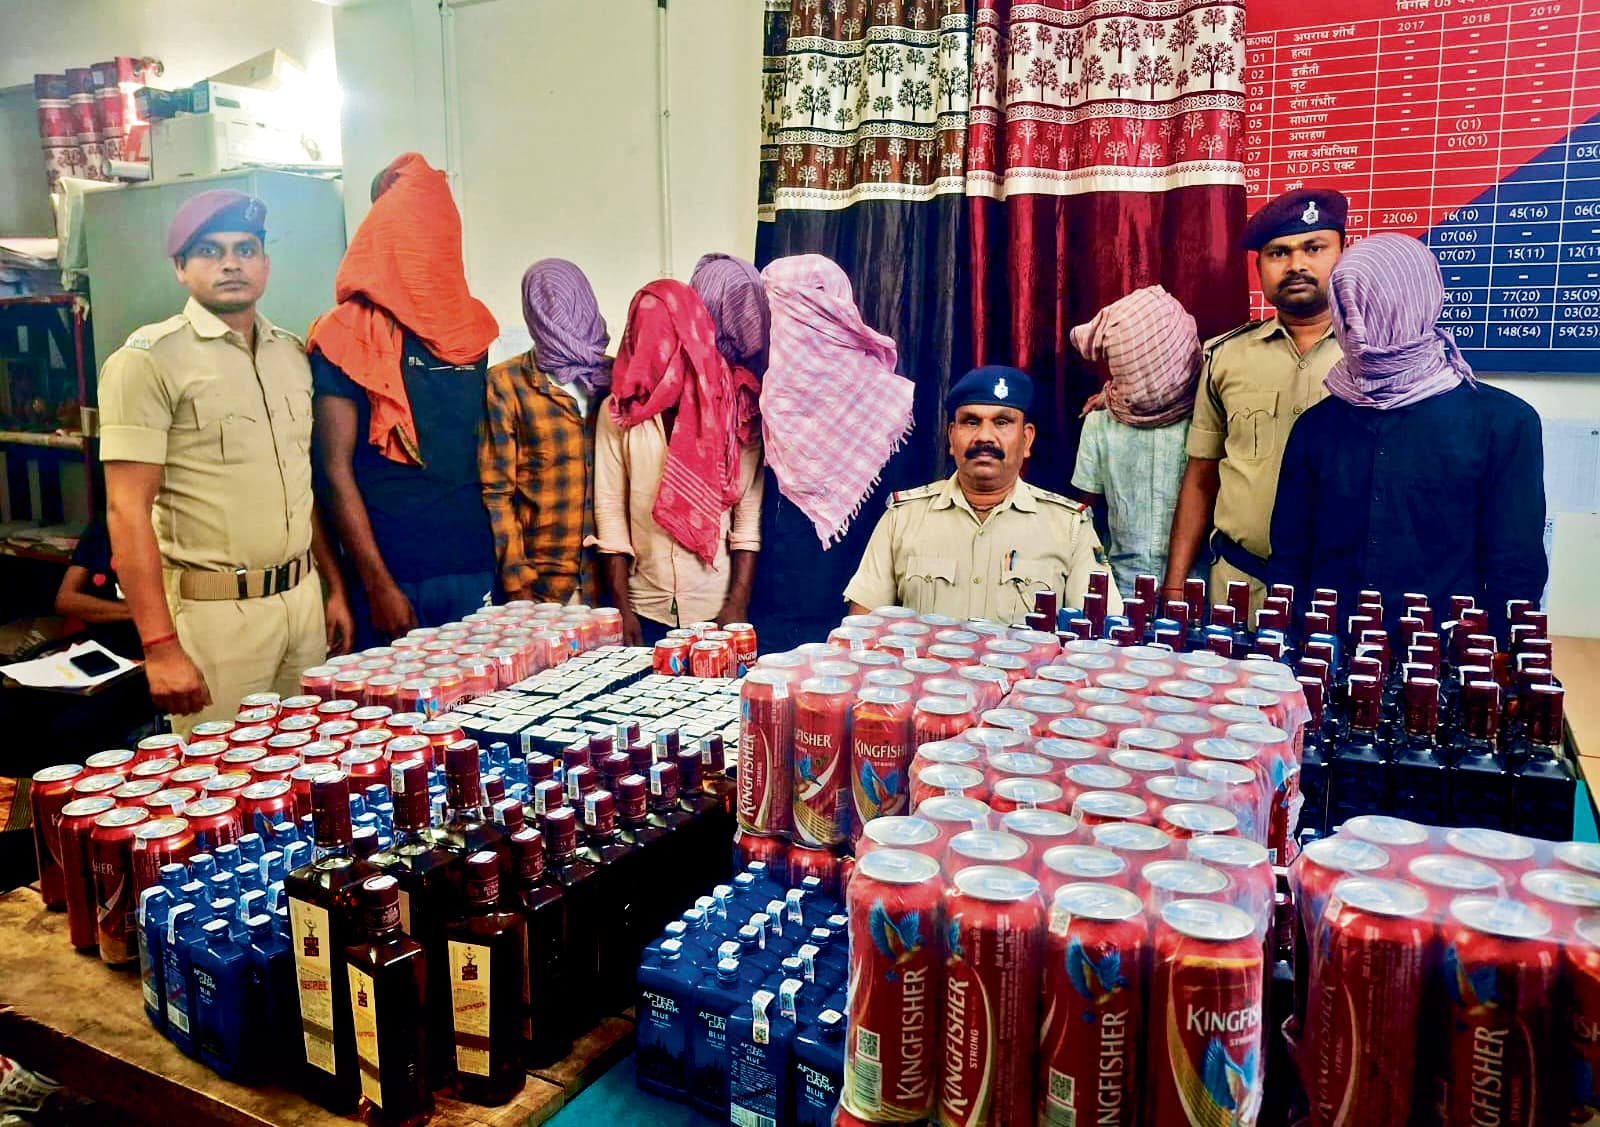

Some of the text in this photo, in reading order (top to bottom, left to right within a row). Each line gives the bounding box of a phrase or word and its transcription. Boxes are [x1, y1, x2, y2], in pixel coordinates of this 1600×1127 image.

[1397, 20, 1424, 31] 2017
[1462, 13, 1491, 25] 2018
[1529, 4, 1561, 17] 2019
[1252, 53, 1265, 63] 01
[1251, 69, 1265, 80] 02
[1250, 86, 1264, 96] 03
[1249, 102, 1263, 112] 04
[1249, 118, 1263, 129] 05
[1455, 117, 1481, 132] (01)
[1248, 136, 1262, 145] 06
[1447, 134, 1488, 148] 01(01)
[1247, 151, 1261, 161] 07
[1576, 144, 1600, 158] 03(
[1246, 168, 1260, 177] 08
[1246, 184, 1260, 193] 09
[1382, 212, 1418, 225] 22(06)
[1443, 208, 1479, 221] 16(10)
[1509, 206, 1549, 219] 45(16)
[1440, 230, 1478, 243] 07(06)
[1439, 248, 1477, 261] 07(07)
[1507, 247, 1545, 260] 15(11)
[1443, 290, 1473, 303] 9(10)
[1503, 289, 1541, 302] 77(20)
[1442, 306, 1600, 320] 6(16) 11(07) 03(02
[1444, 325, 1474, 338] 7(50)
[1497, 325, 1541, 338] 148(54)
[795, 729, 832, 748] FISHER
[854, 738, 904, 758] KINGFISH
[651, 1009, 669, 1021] BLUE
[698, 1011, 726, 1025] AFTE
[896, 965, 929, 1101] KINGFISHER
[943, 976, 971, 1117] KINGFISHER
[969, 1028, 980, 1070] STRONG
[1097, 1008, 1129, 1127] NGFISHER
[1471, 1026, 1510, 1127] GFISHER
[805, 1084, 825, 1100] BLUE
